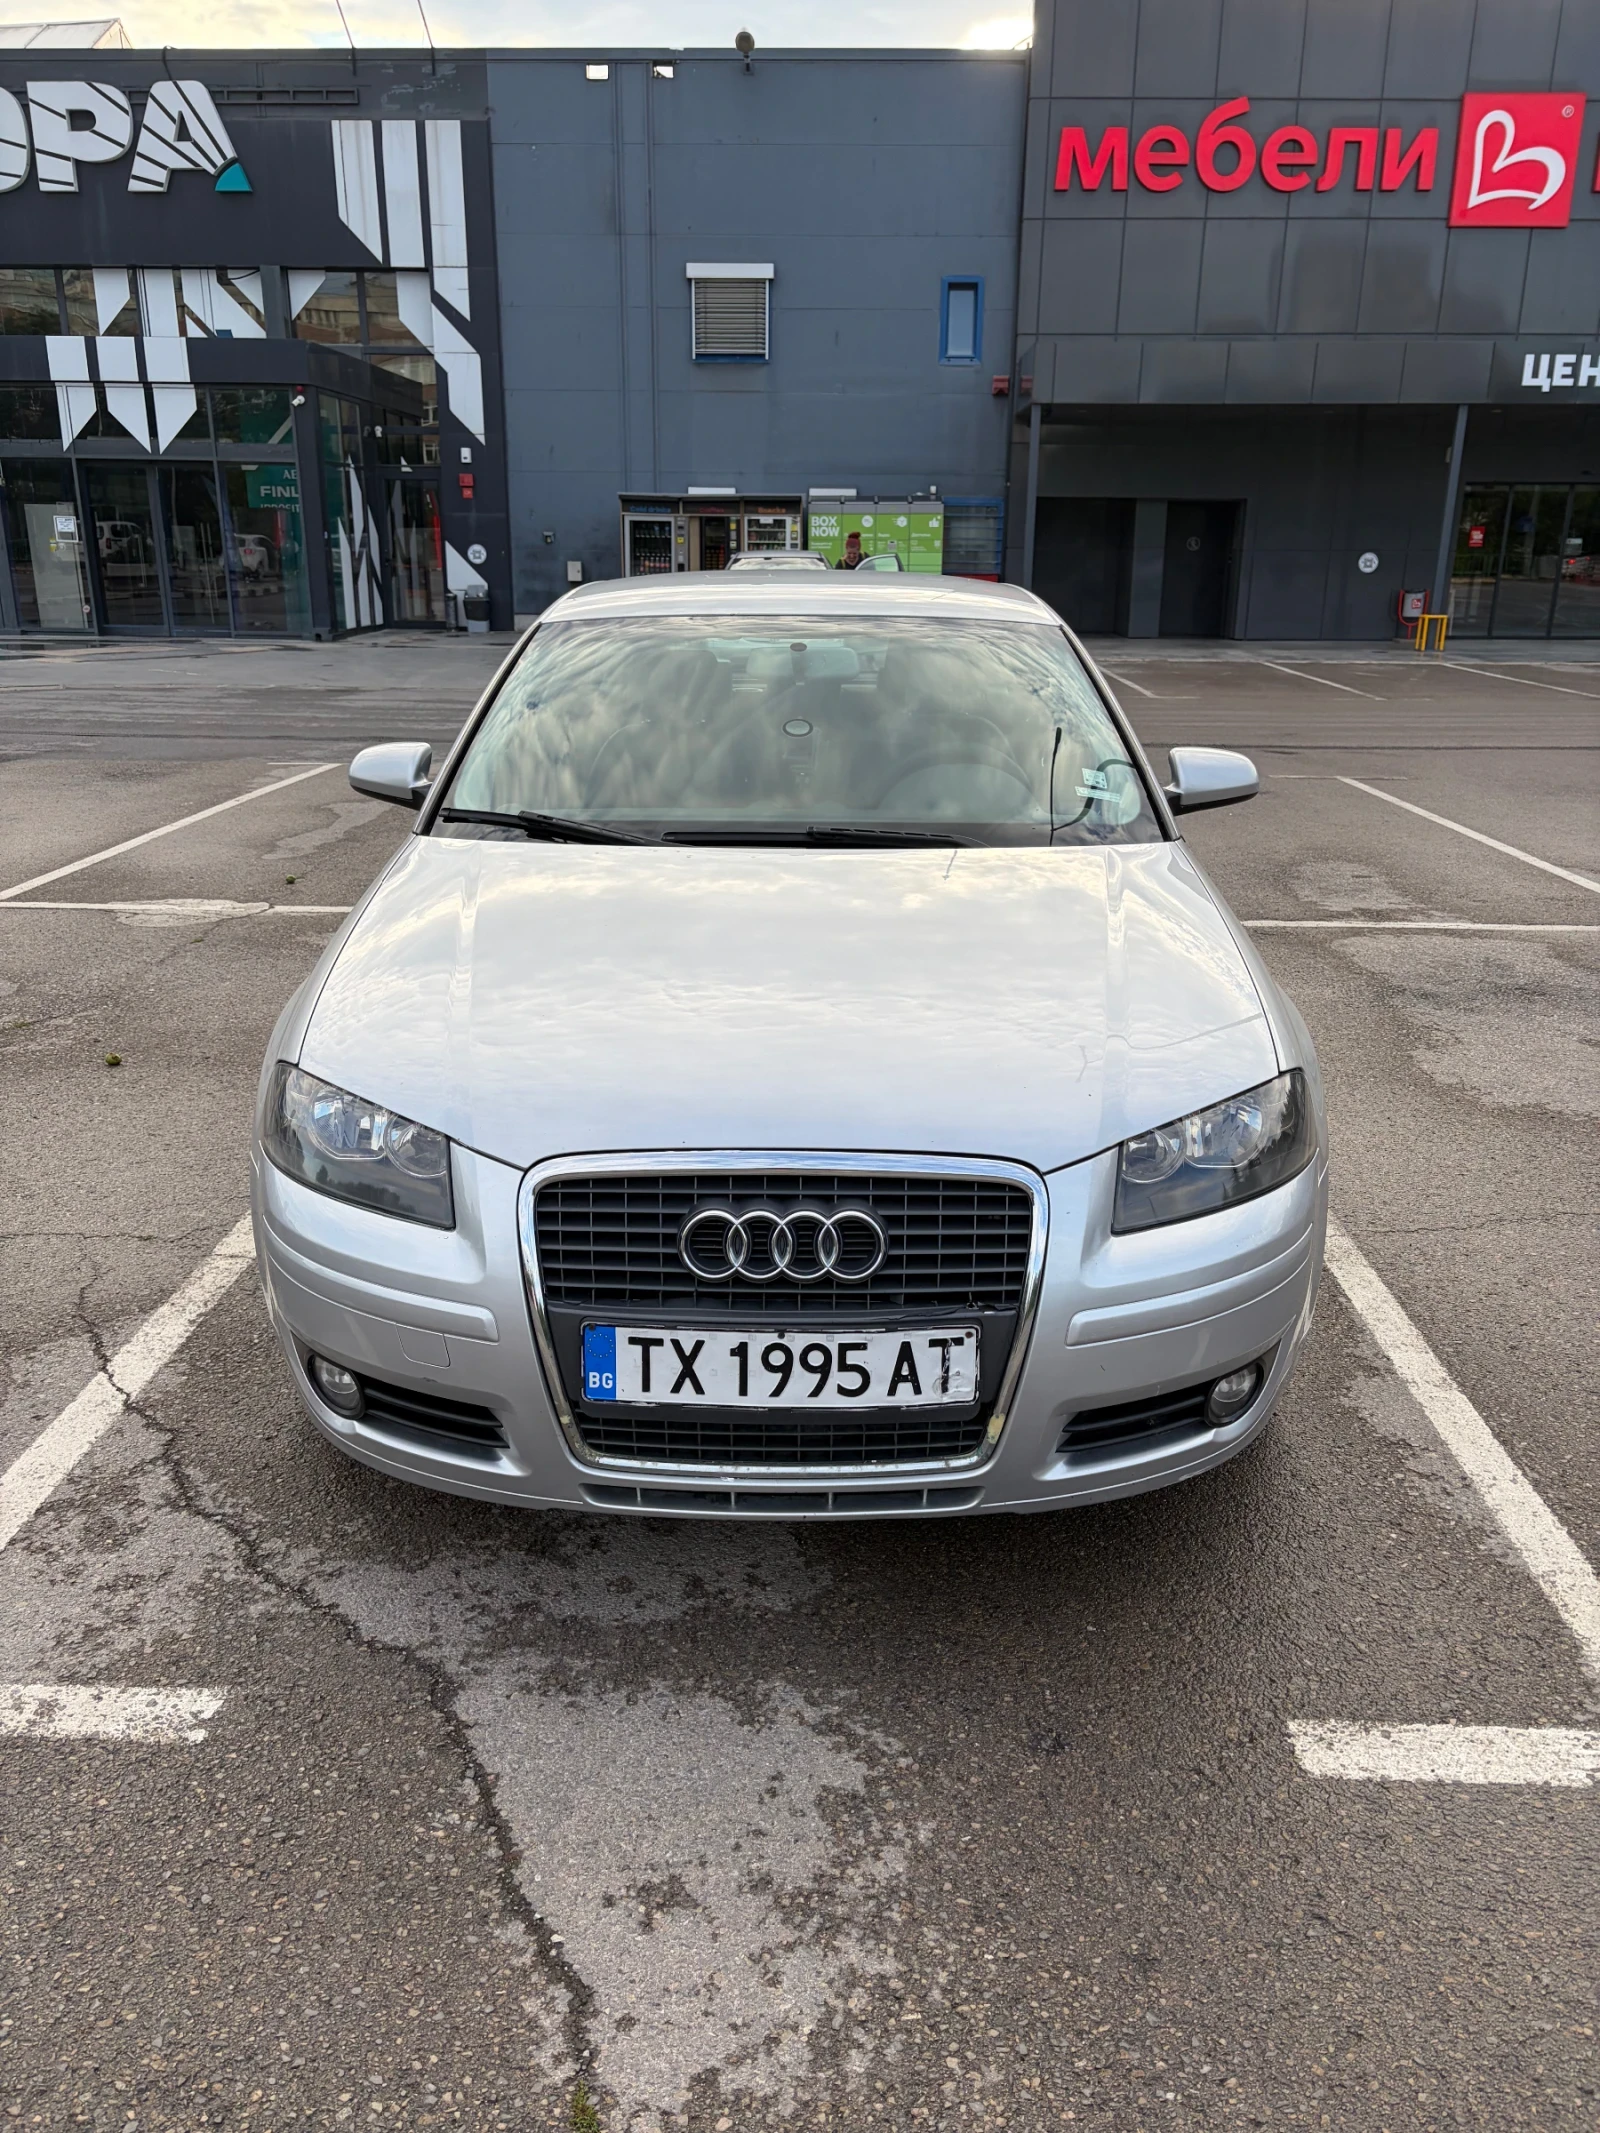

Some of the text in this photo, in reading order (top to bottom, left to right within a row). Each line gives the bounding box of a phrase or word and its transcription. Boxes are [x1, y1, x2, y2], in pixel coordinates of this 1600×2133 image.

[0, 80, 252, 193] РА
[1054, 96, 1440, 192] мебели
[1521, 354, 1600, 393] ЦЕН
[811, 515, 838, 527] BOX
[811, 526, 840, 537] NOW
[588, 1371, 614, 1389] BG
[628, 1336, 965, 1398] TX 1995 AT
